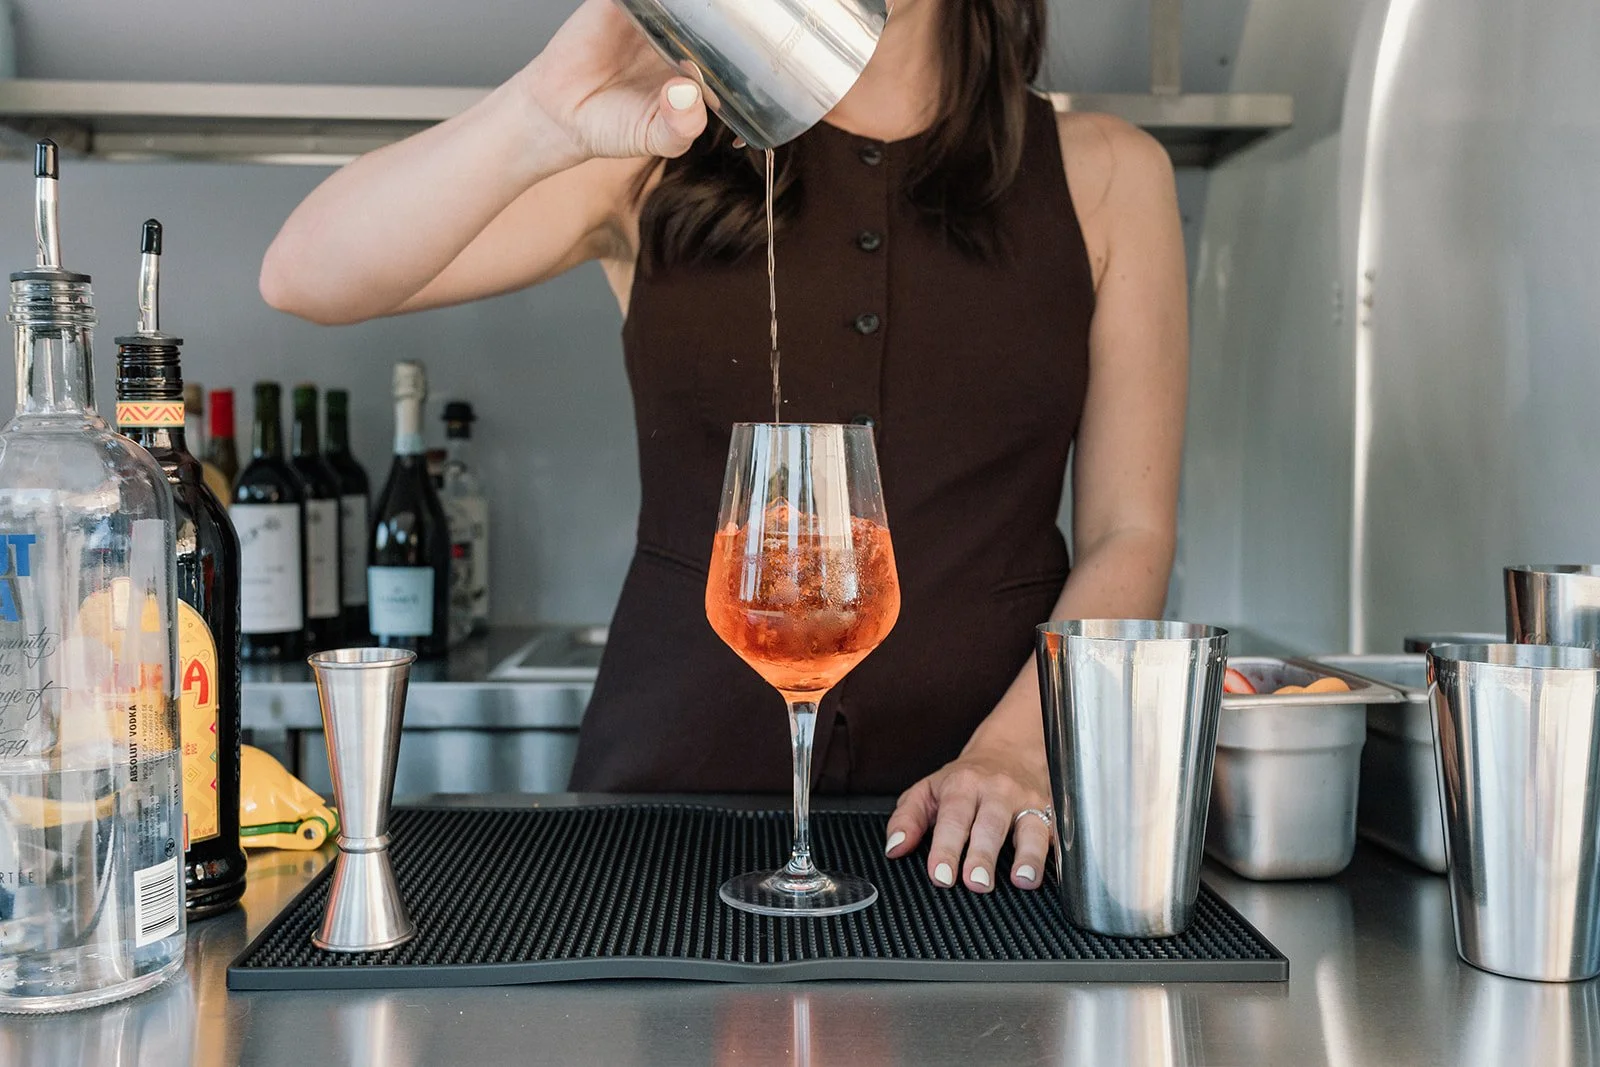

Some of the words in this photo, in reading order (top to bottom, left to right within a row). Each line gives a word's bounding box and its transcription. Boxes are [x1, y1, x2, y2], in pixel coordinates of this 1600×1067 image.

[26, 680, 69, 721] of
[180, 658, 209, 705] A
[128, 704, 137, 737] VODKA
[130, 742, 138, 782] ABSOLUT
